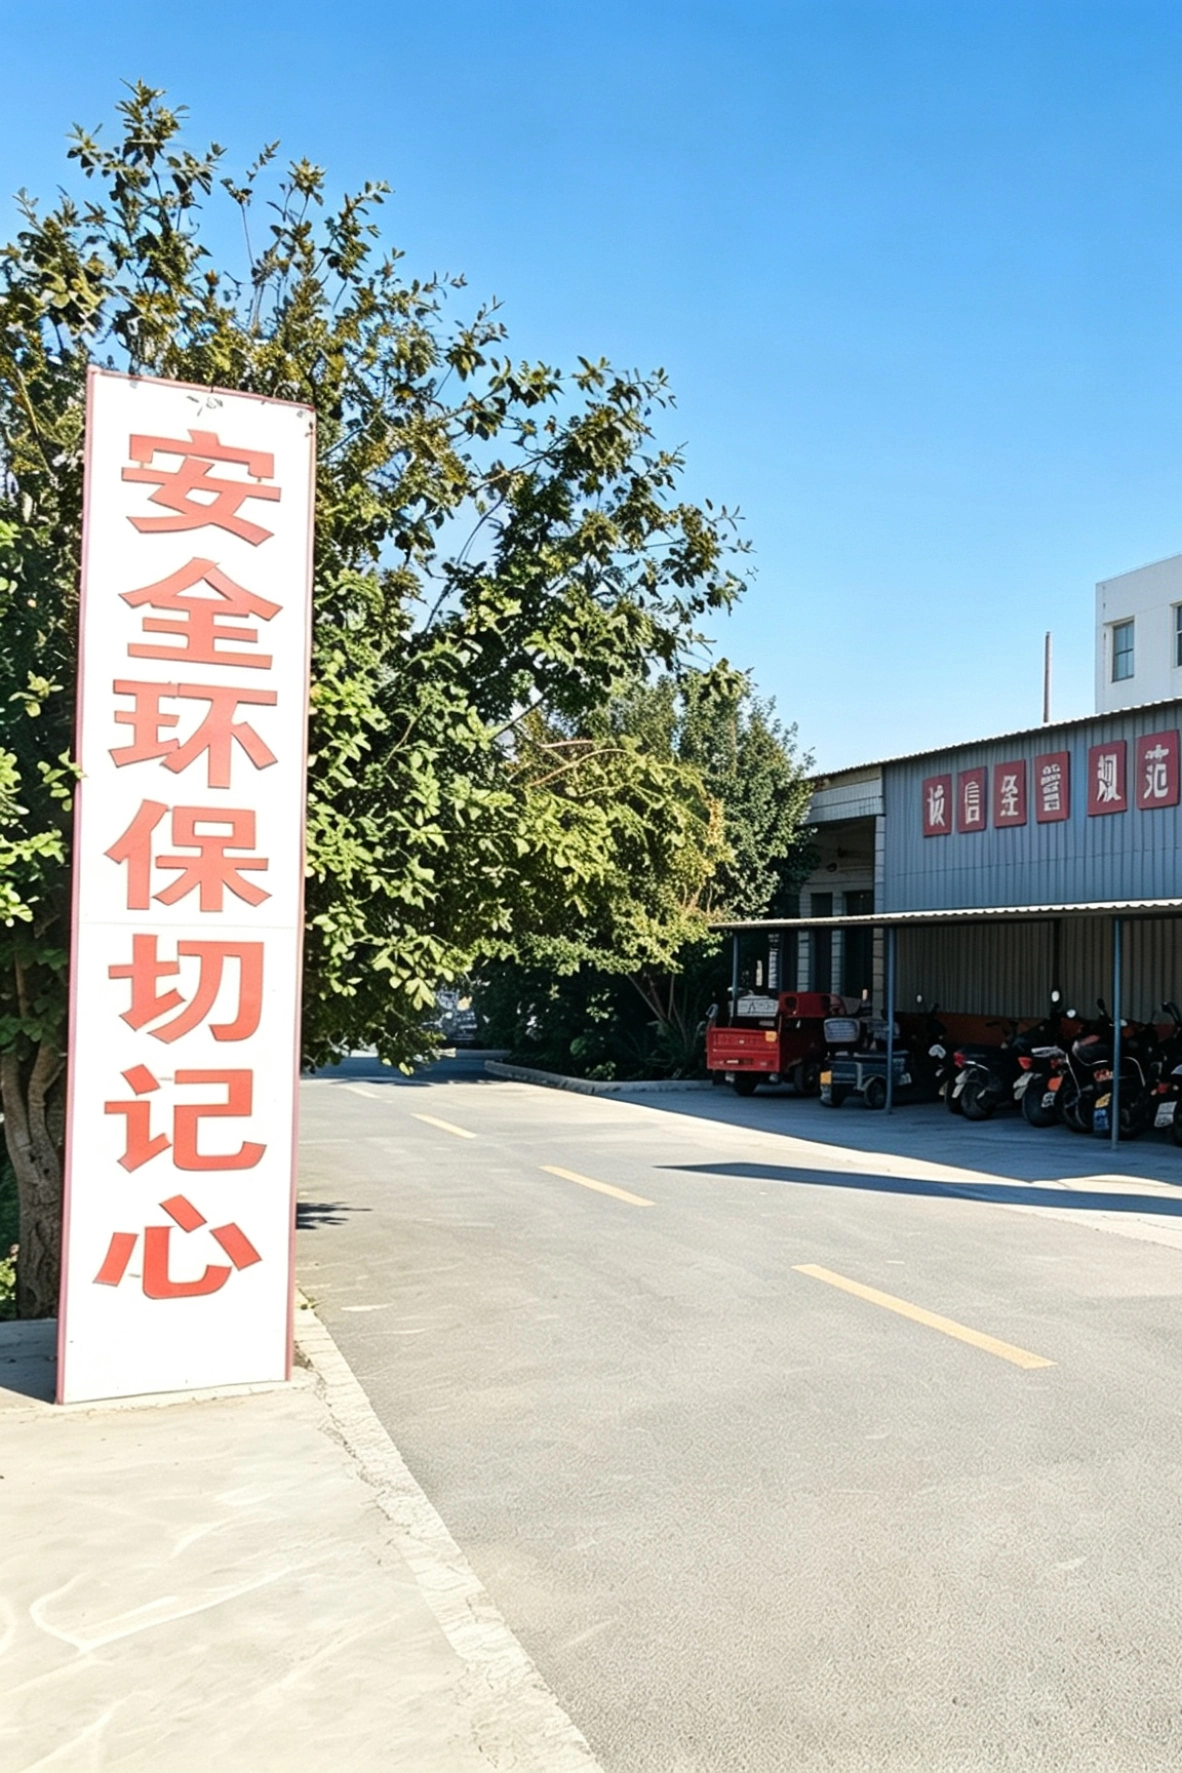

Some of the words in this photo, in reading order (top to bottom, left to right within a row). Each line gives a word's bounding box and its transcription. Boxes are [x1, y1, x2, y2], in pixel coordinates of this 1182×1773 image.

[92, 429, 283, 1301] 安全环保切记心
